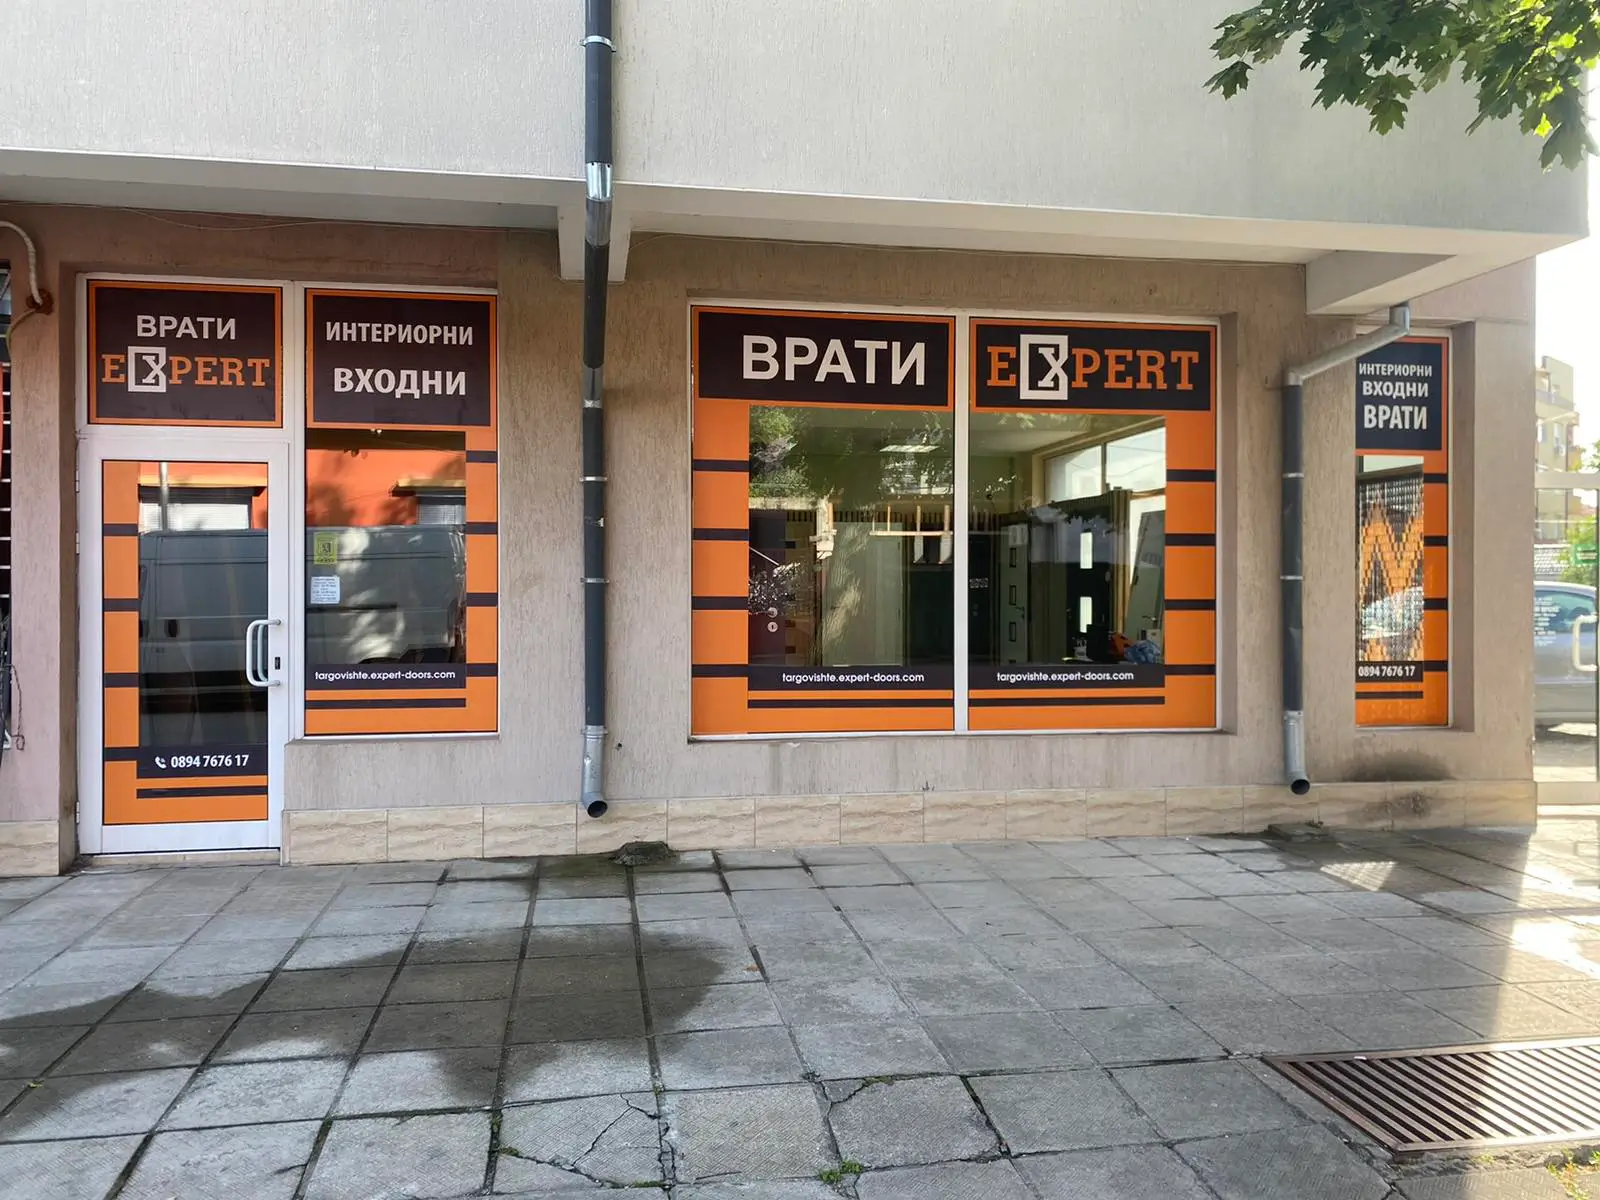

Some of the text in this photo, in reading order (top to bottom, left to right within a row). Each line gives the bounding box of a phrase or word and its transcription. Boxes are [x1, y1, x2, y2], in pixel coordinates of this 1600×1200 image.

[137, 315, 237, 340] ВРАТИ
[325, 321, 474, 346] ИНТЕРИОРНИ
[101, 345, 271, 393] EXPERT
[742, 334, 926, 386] ВРАТИ
[986, 334, 1200, 400] EXPERT
[1358, 363, 1433, 377] ИНТЕРИОРНИ
[333, 367, 467, 399] ВХОДНИ
[1361, 381, 1429, 399] ВХОДНИ
[1363, 404, 1428, 430] ВРАТИ
[314, 670, 456, 682] targovishte.expert-doors.com
[782, 672, 925, 685] targovishte.expert-doors.com
[996, 671, 1135, 684] targovishte.expert-doors.com
[170, 754, 250, 769] 0894 7676 17
